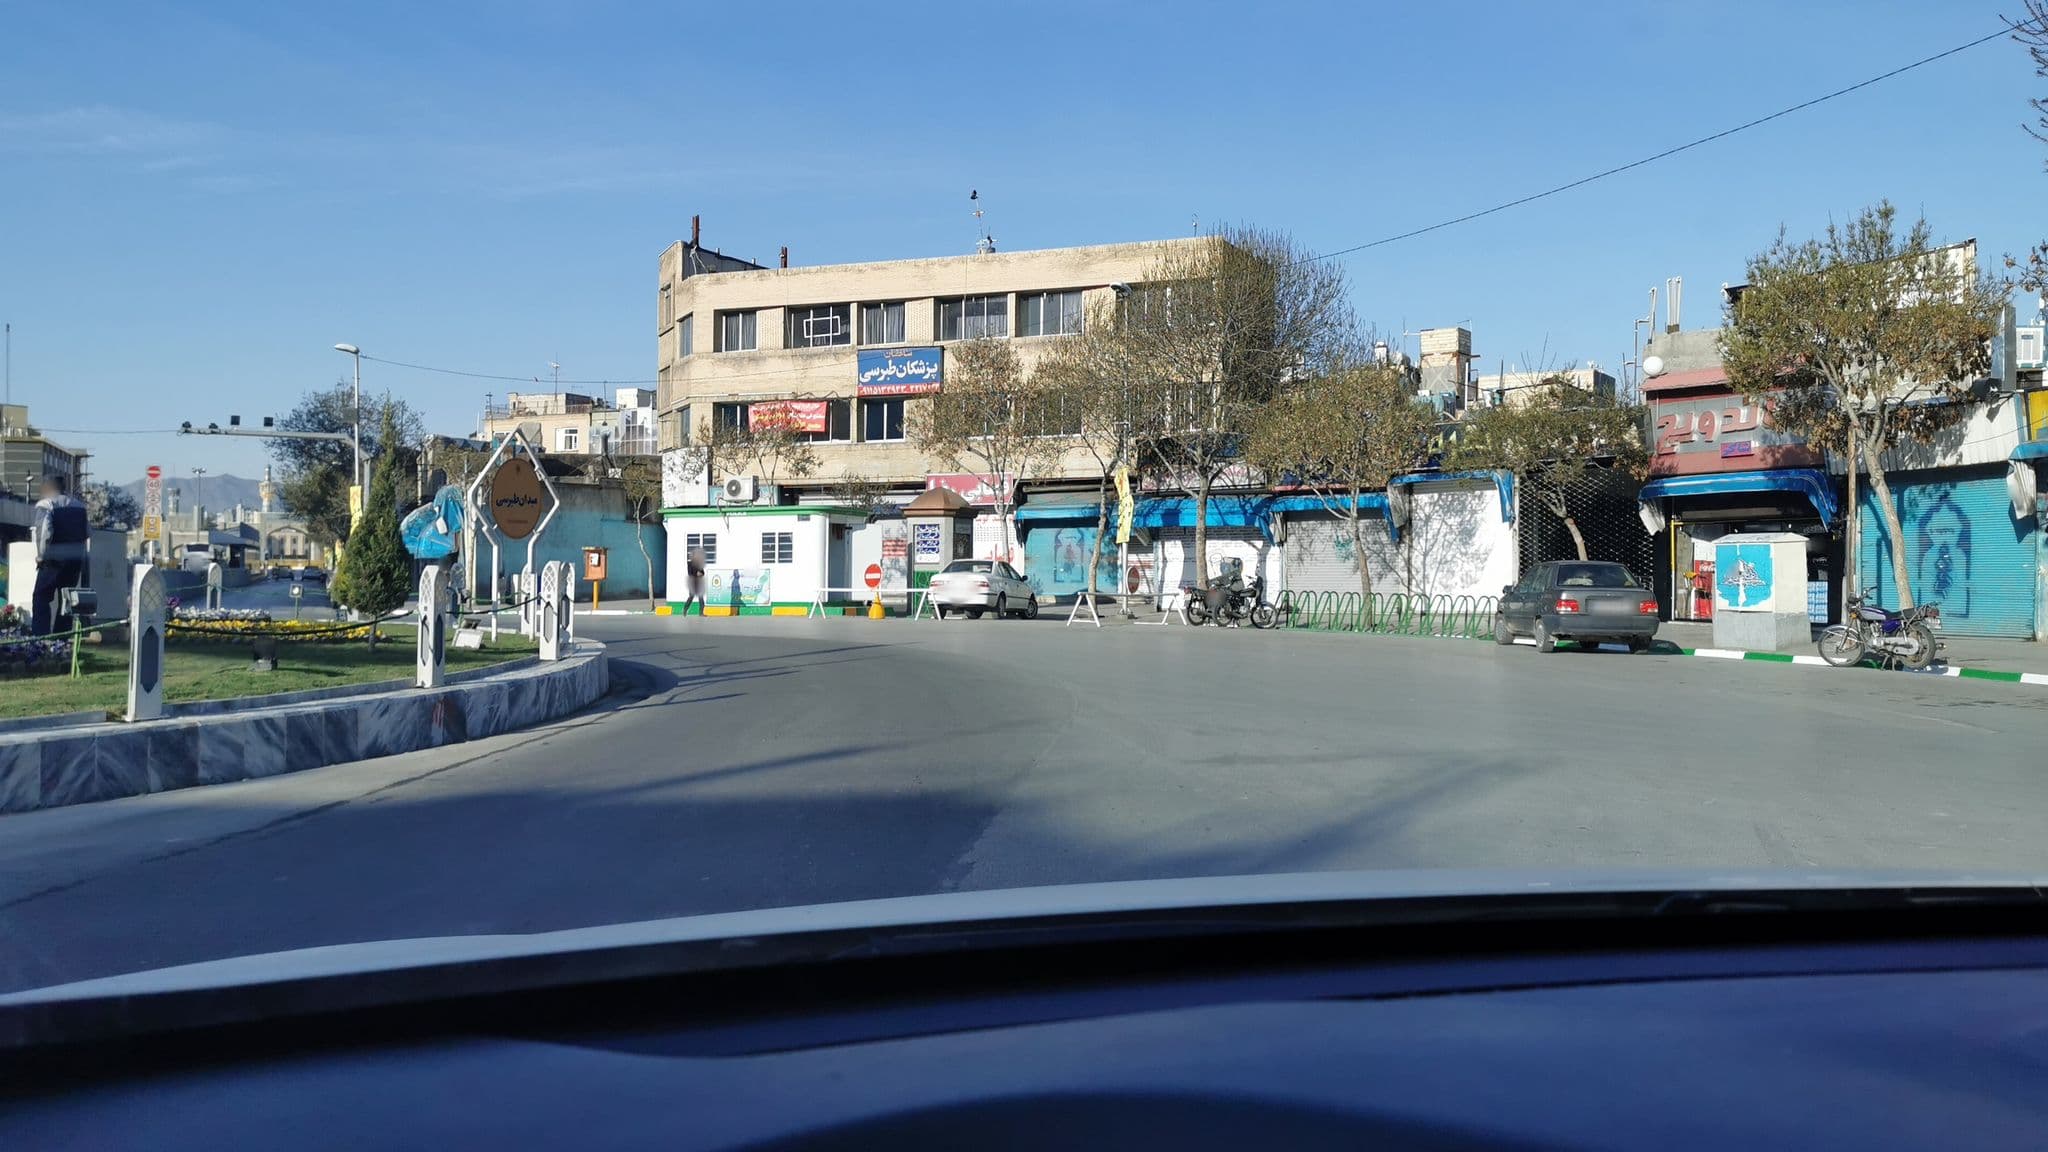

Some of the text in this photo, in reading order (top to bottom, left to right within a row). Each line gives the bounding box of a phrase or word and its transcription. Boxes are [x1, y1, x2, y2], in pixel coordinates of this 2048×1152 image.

[859, 359, 938, 383] پزشکان طبرسی
[496, 492, 538, 508] میدان طبرسی
